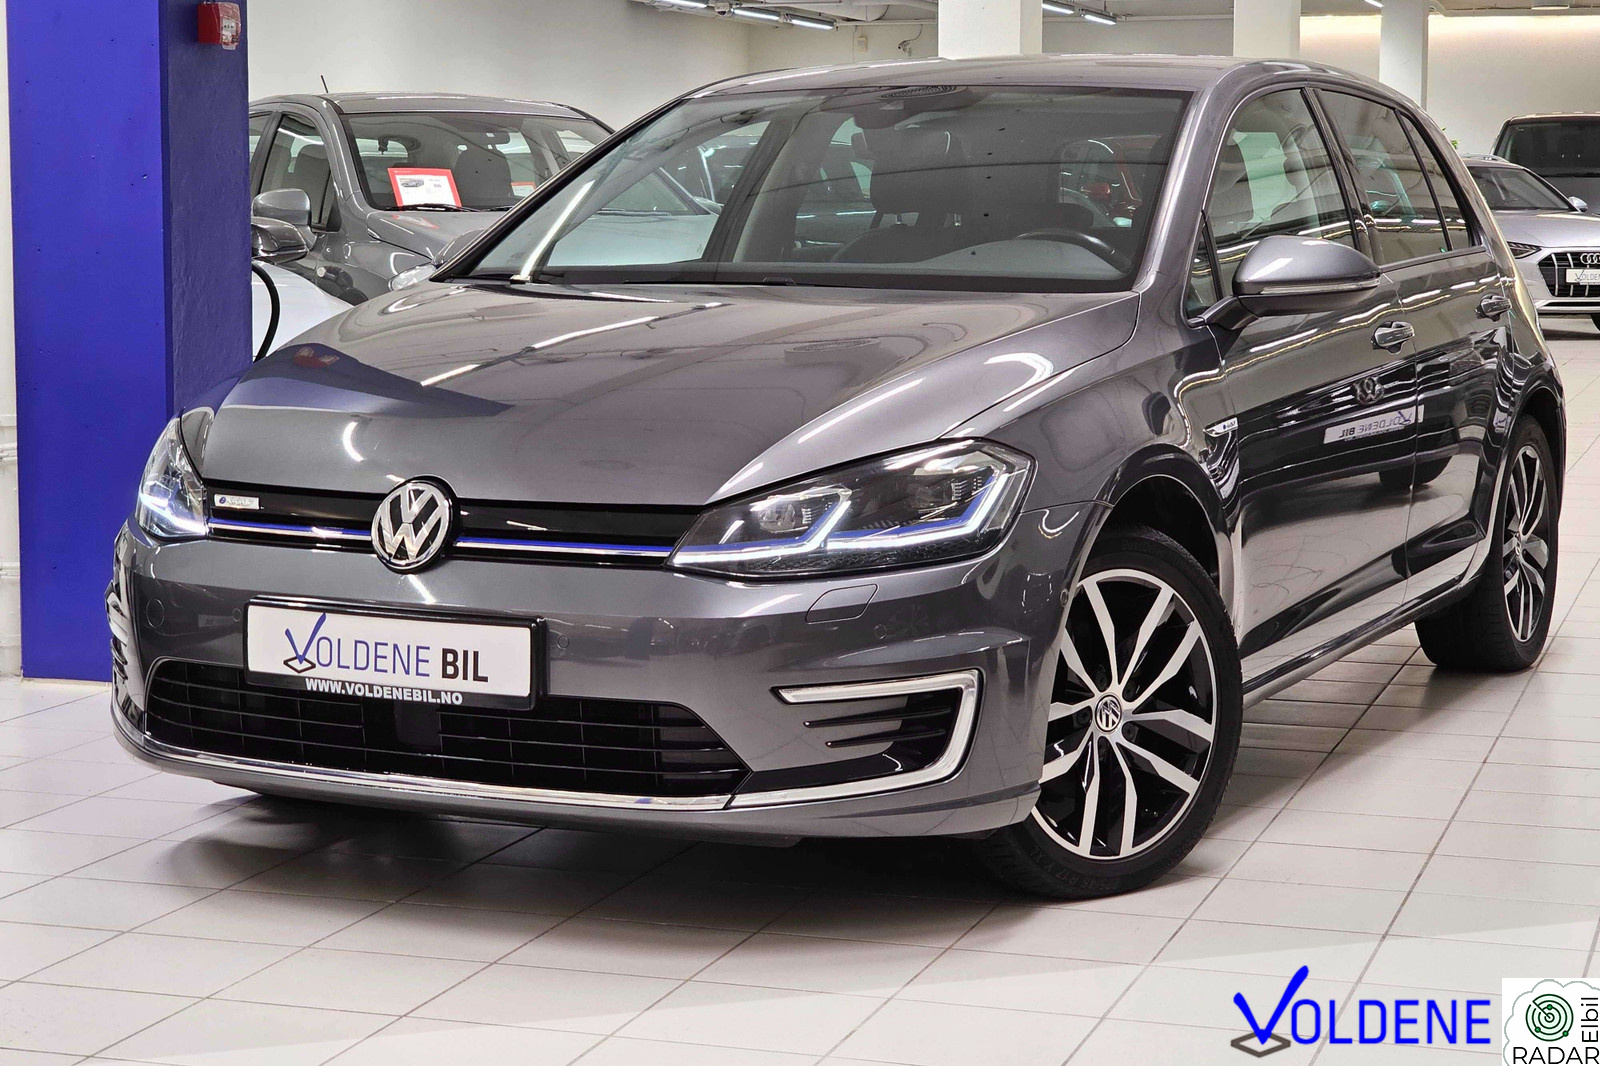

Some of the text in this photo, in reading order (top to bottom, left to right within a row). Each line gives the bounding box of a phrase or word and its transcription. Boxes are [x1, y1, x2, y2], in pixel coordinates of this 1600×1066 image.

[1575, 269, 1600, 281] VOLDE
[371, 482, 450, 570] VW
[285, 612, 489, 682] VOLDENE BIL
[305, 678, 463, 705] WWW.VOLDENEBIL.NO
